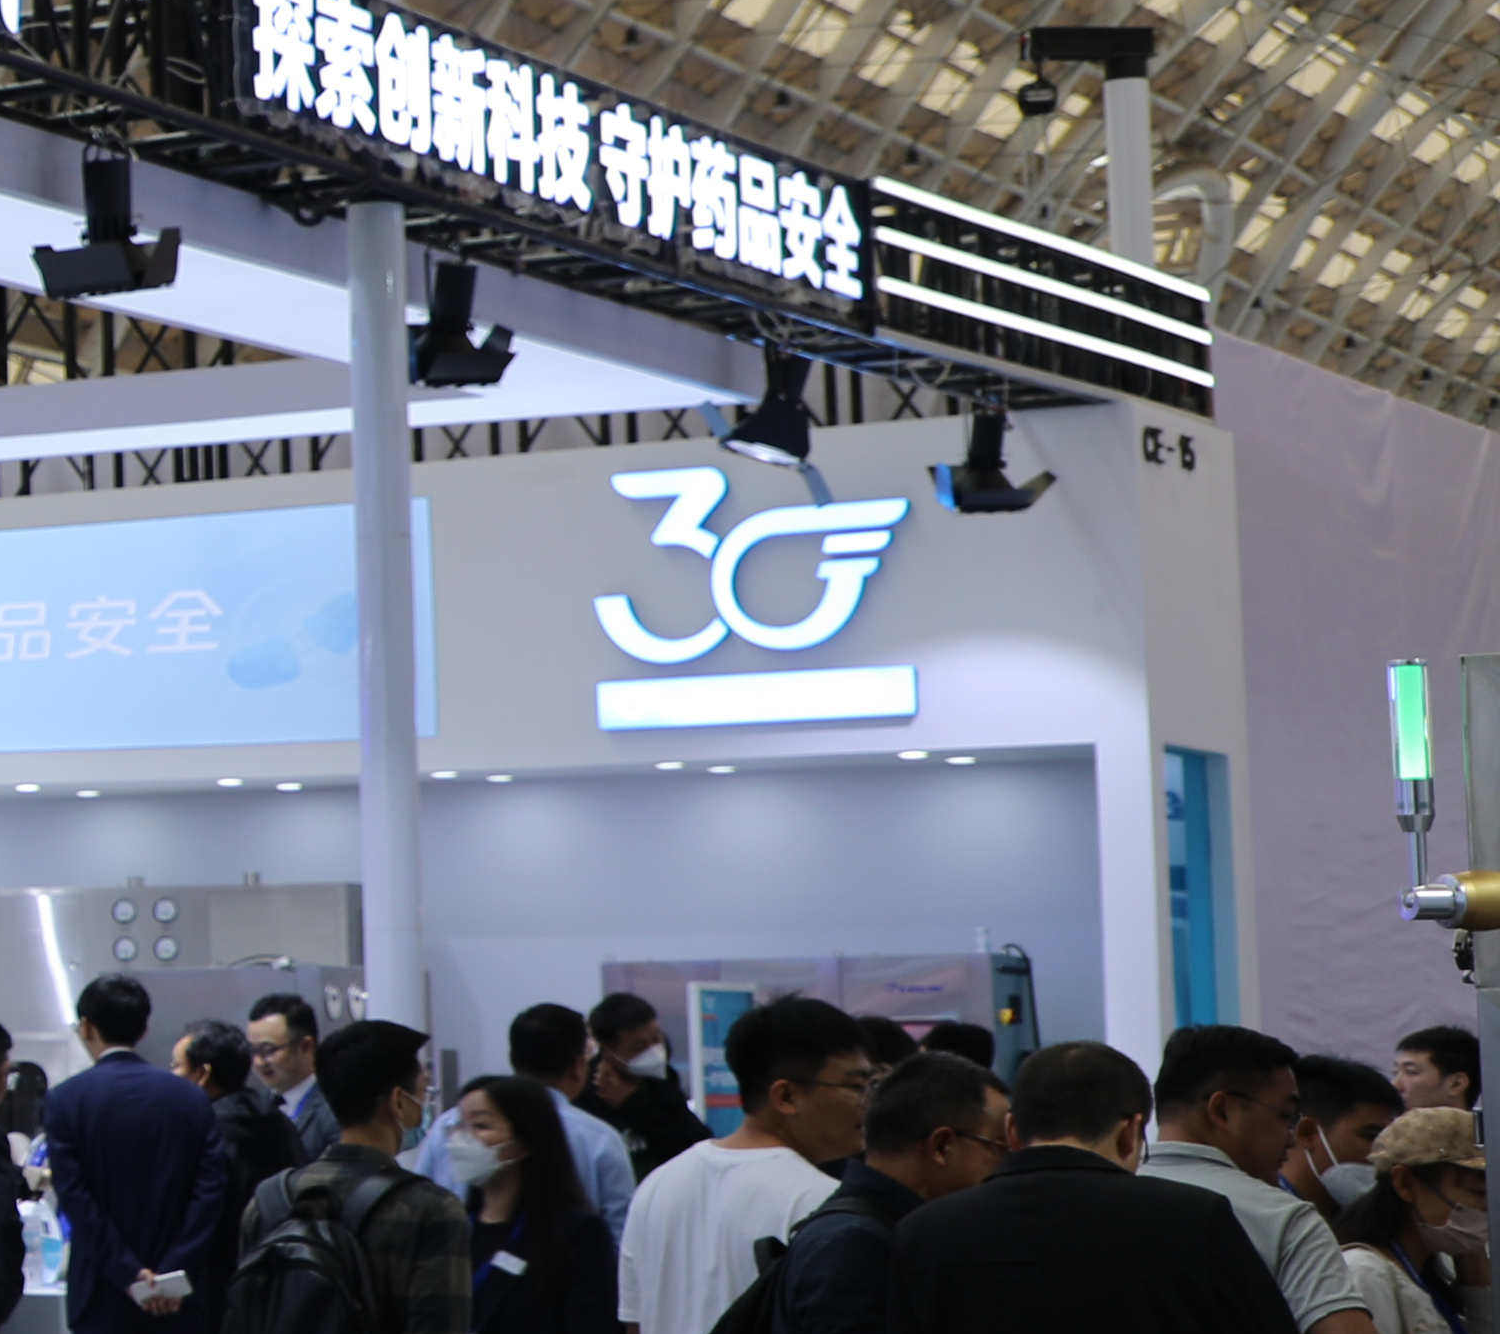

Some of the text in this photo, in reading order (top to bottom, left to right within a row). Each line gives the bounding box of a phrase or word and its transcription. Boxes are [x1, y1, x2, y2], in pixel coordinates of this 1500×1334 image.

[598, 100, 864, 302] 守护药品安全
